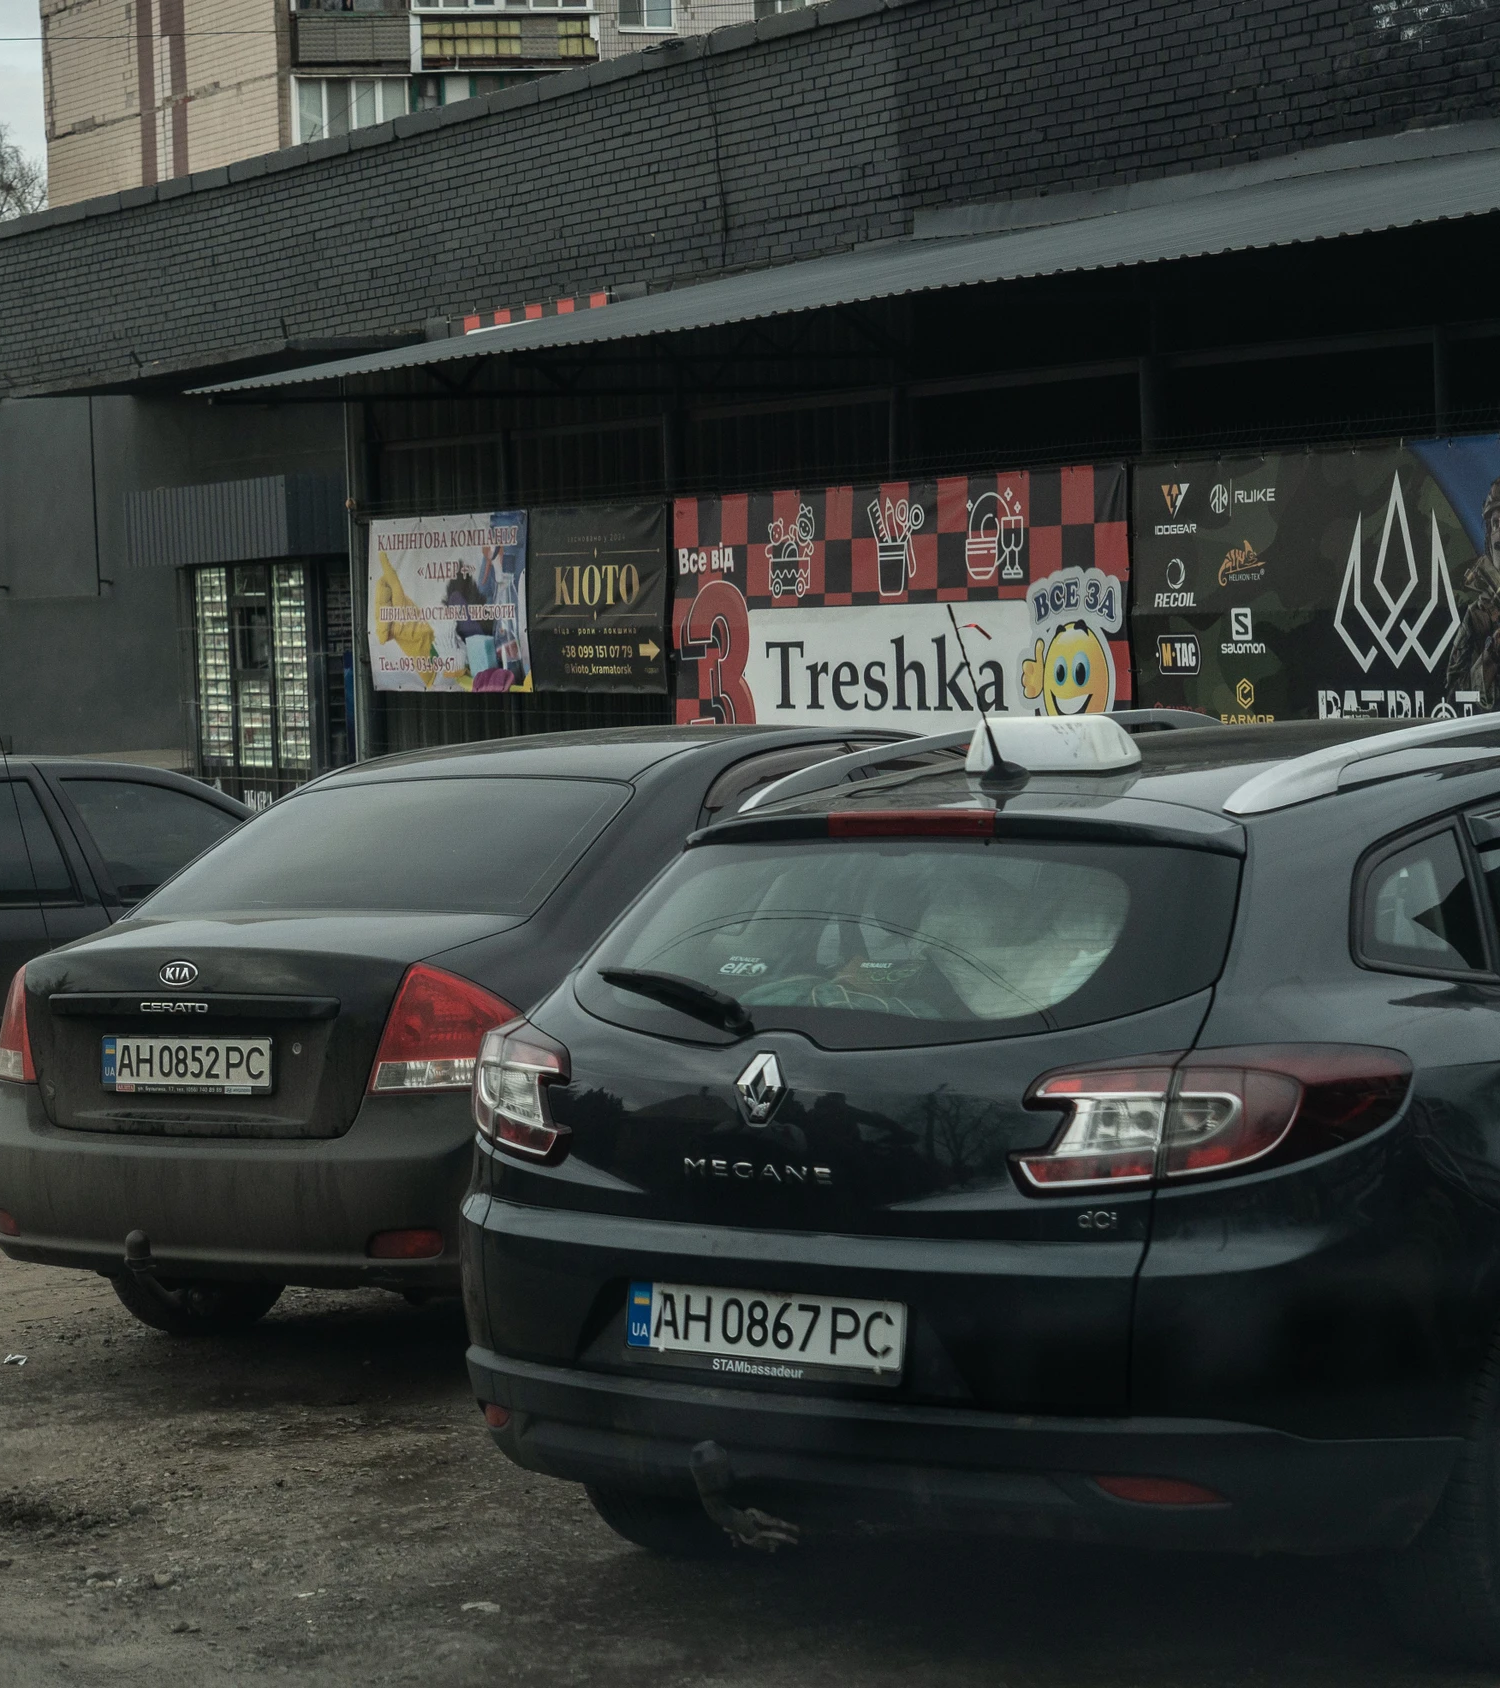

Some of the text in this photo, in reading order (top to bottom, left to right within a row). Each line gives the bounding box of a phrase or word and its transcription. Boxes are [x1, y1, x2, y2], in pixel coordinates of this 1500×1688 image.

[1234, 488, 1276, 504] RUIKE
[1154, 523, 1197, 535] IDOGEAR
[377, 526, 518, 551] КЛІНІНГОВА КОМПАНІЯ
[678, 542, 734, 575] Все від
[554, 563, 640, 606] КІОТО
[1033, 578, 1080, 624] ВСЕ
[1154, 592, 1197, 608] RECOIL
[380, 603, 515, 621] ШВИДКА ДОСТАВКА ЧИСТОТИ
[578, 628, 596, 636] роли
[603, 627, 637, 635] локшина
[561, 645, 633, 658] +38 099 151 07 79
[400, 656, 415, 671] 093
[564, 662, 632, 676] @kioto_kramatorsk
[766, 634, 1009, 711] Treshka
[1220, 713, 1275, 724] EARMOR
[165, 967, 190, 981] KIA
[719, 962, 752, 975] elf
[140, 1002, 209, 1013] CERATO
[104, 1066, 116, 1077] UA
[684, 1157, 832, 1185] MEGANE
[1078, 1210, 1117, 1229] dCi
[632, 1322, 649, 1337] UA
[712, 1357, 803, 1380] STAMbassadeur
